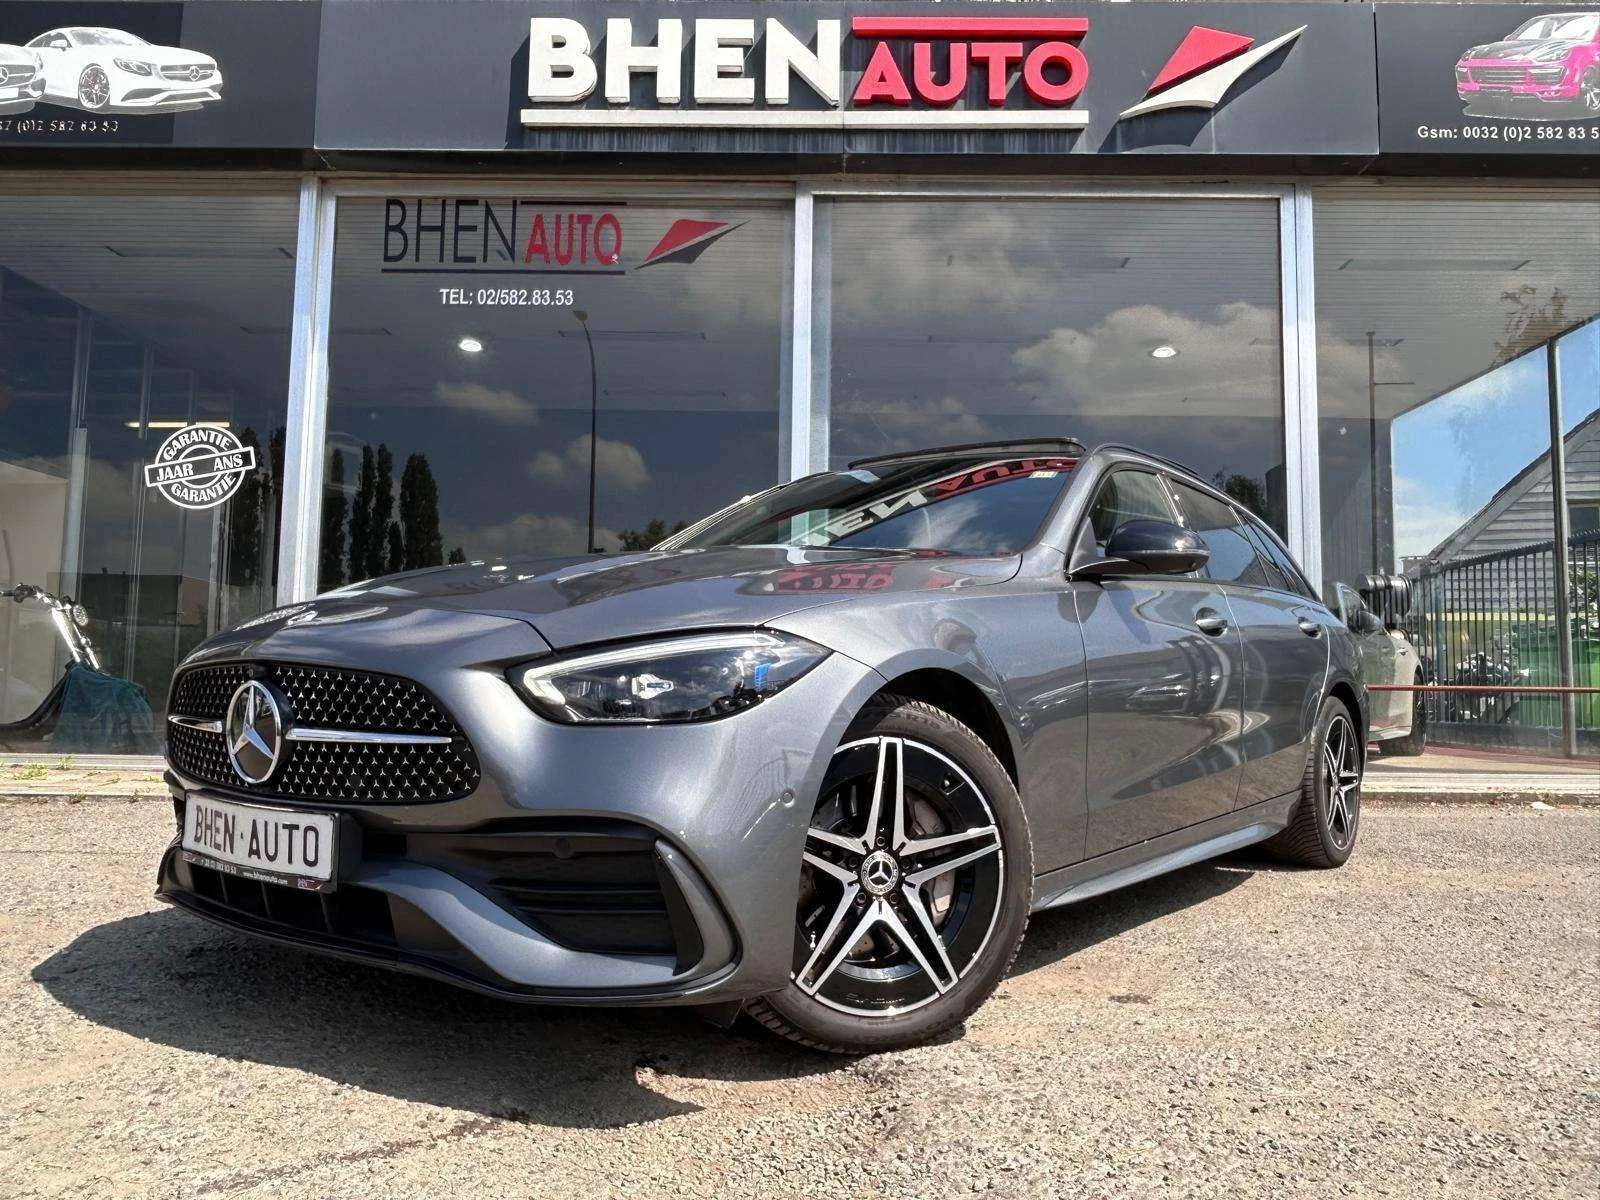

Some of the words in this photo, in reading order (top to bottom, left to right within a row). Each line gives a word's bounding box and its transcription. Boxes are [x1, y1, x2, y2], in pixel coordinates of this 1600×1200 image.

[528, 18, 841, 107] BHEN
[853, 41, 1090, 106] AUTO
[1417, 125, 1458, 138] Gsm:
[1463, 126, 1499, 139] 0032
[1503, 126, 1531, 141] (0)2
[1537, 126, 1563, 139] 582
[1568, 127, 1586, 139] 83
[383, 198, 518, 264] BHEN
[524, 213, 623, 265] AUTO
[440, 289, 473, 305] TEL:
[477, 289, 574, 306] 02/582.83.53
[163, 429, 232, 460] GARANTIE
[156, 463, 194, 481] JAAR
[213, 454, 244, 472] ANS
[171, 472, 237, 502] GARANTIE
[194, 804, 236, 855] BHEN
[247, 818, 319, 868] AUTO
